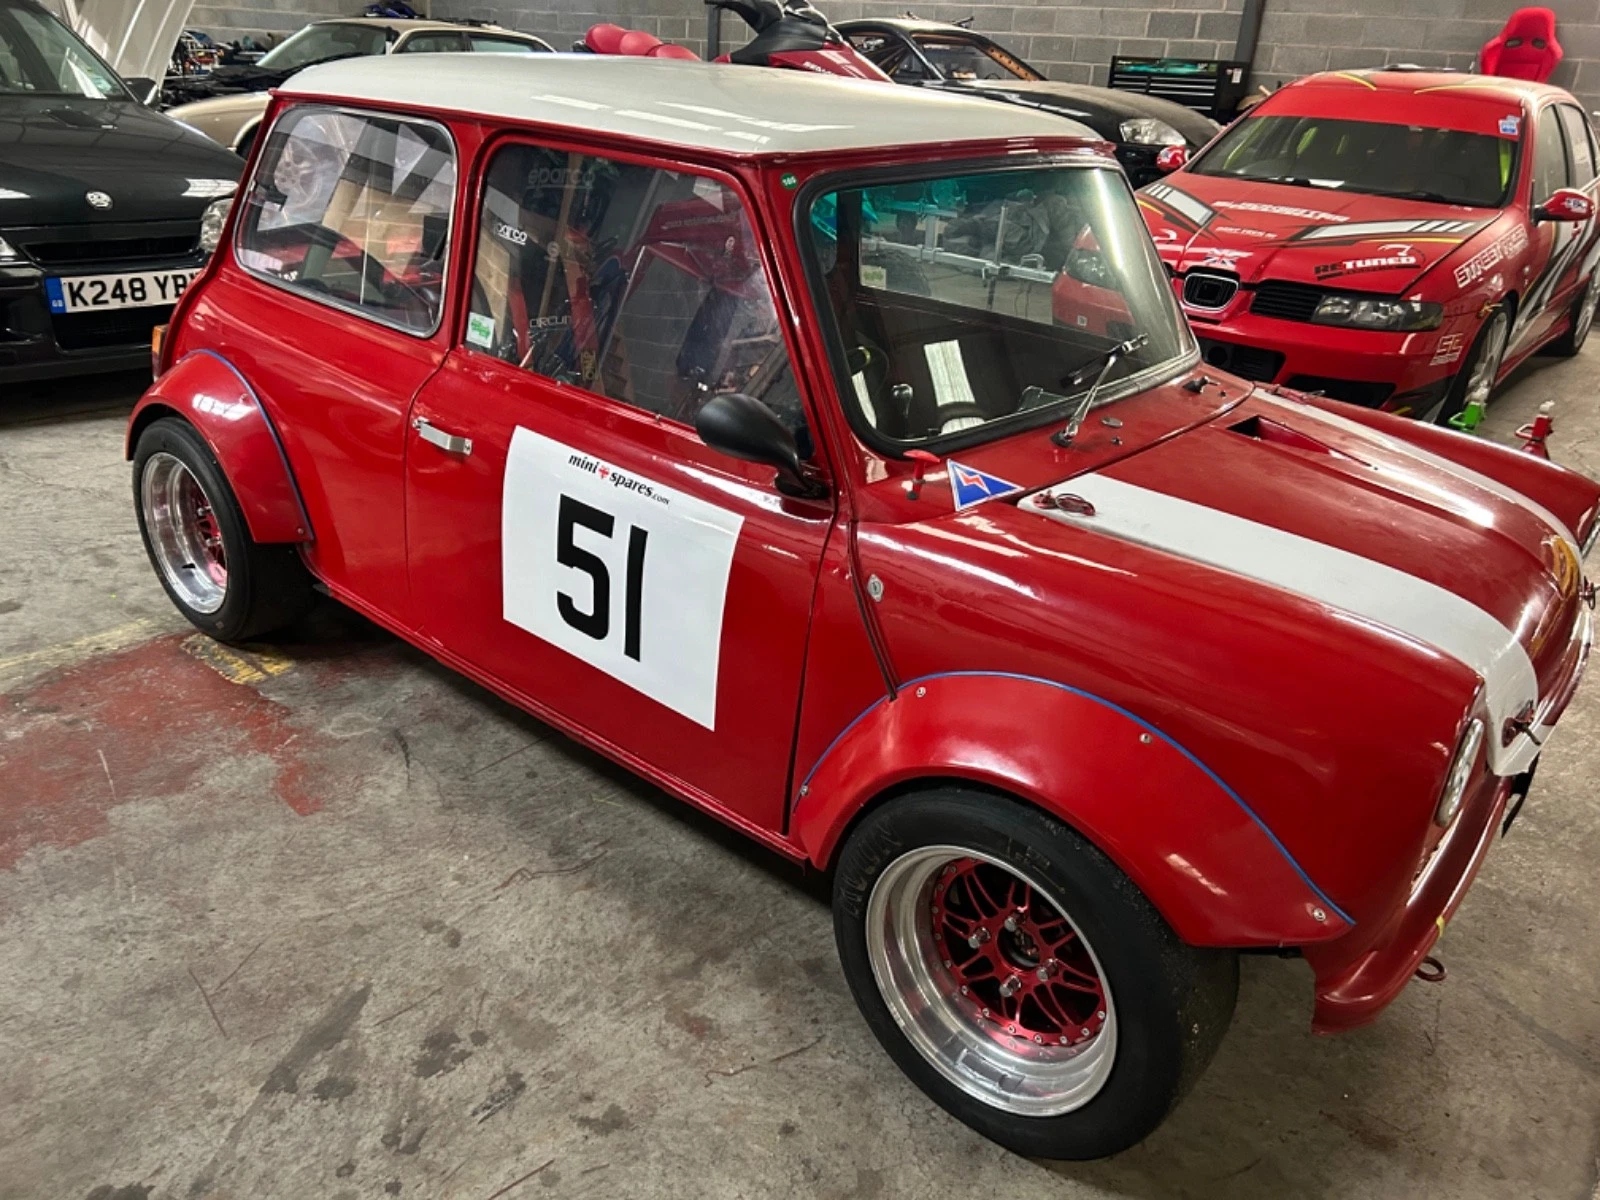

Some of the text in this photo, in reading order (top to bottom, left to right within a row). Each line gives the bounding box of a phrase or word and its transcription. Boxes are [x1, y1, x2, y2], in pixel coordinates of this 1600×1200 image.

[68, 277, 147, 307] K248
[568, 455, 600, 474] mini
[557, 493, 648, 662] 51
